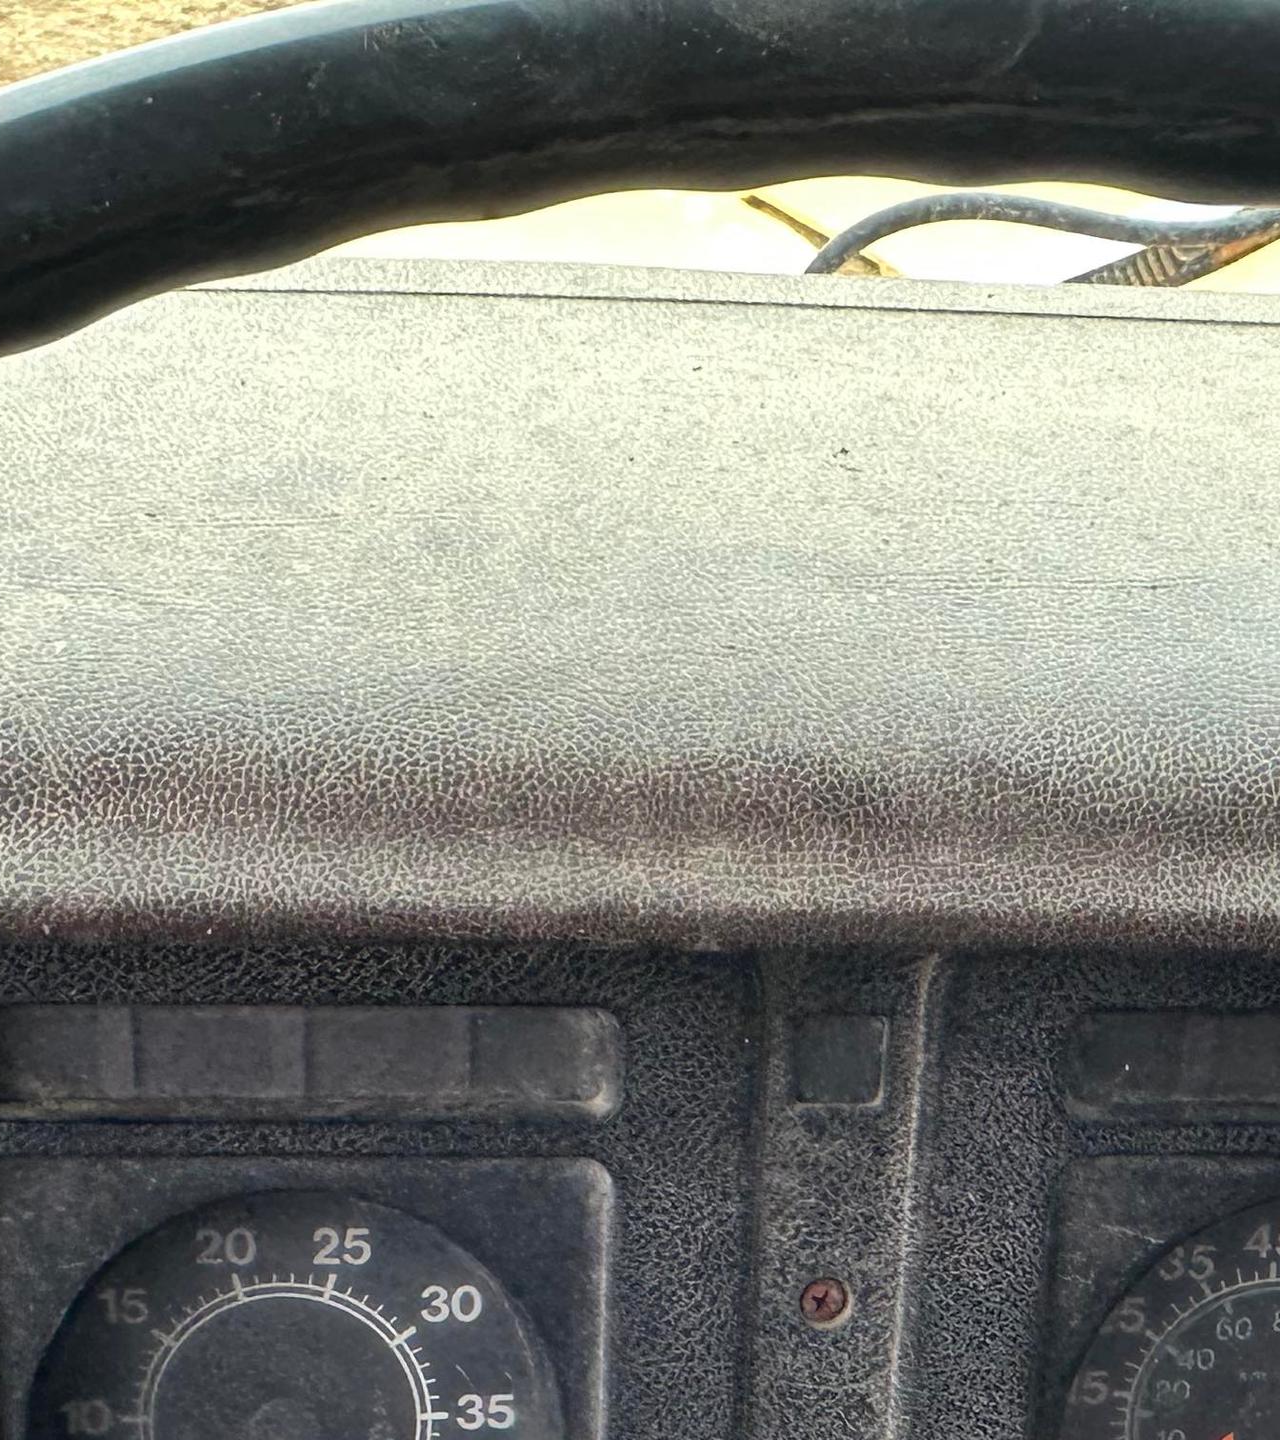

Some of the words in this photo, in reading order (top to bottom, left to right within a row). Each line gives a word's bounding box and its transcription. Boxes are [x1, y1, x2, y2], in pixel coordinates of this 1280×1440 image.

[195, 1228, 257, 1265] 20
[312, 1227, 372, 1265] 25
[1158, 1245, 1215, 1281] 35
[98, 1288, 150, 1325] 15
[420, 1285, 483, 1323] 30
[1216, 1316, 1252, 1341] 60
[1178, 1347, 1215, 1371] 40
[61, 1400, 113, 1435] 10
[456, 1394, 516, 1430] 35
